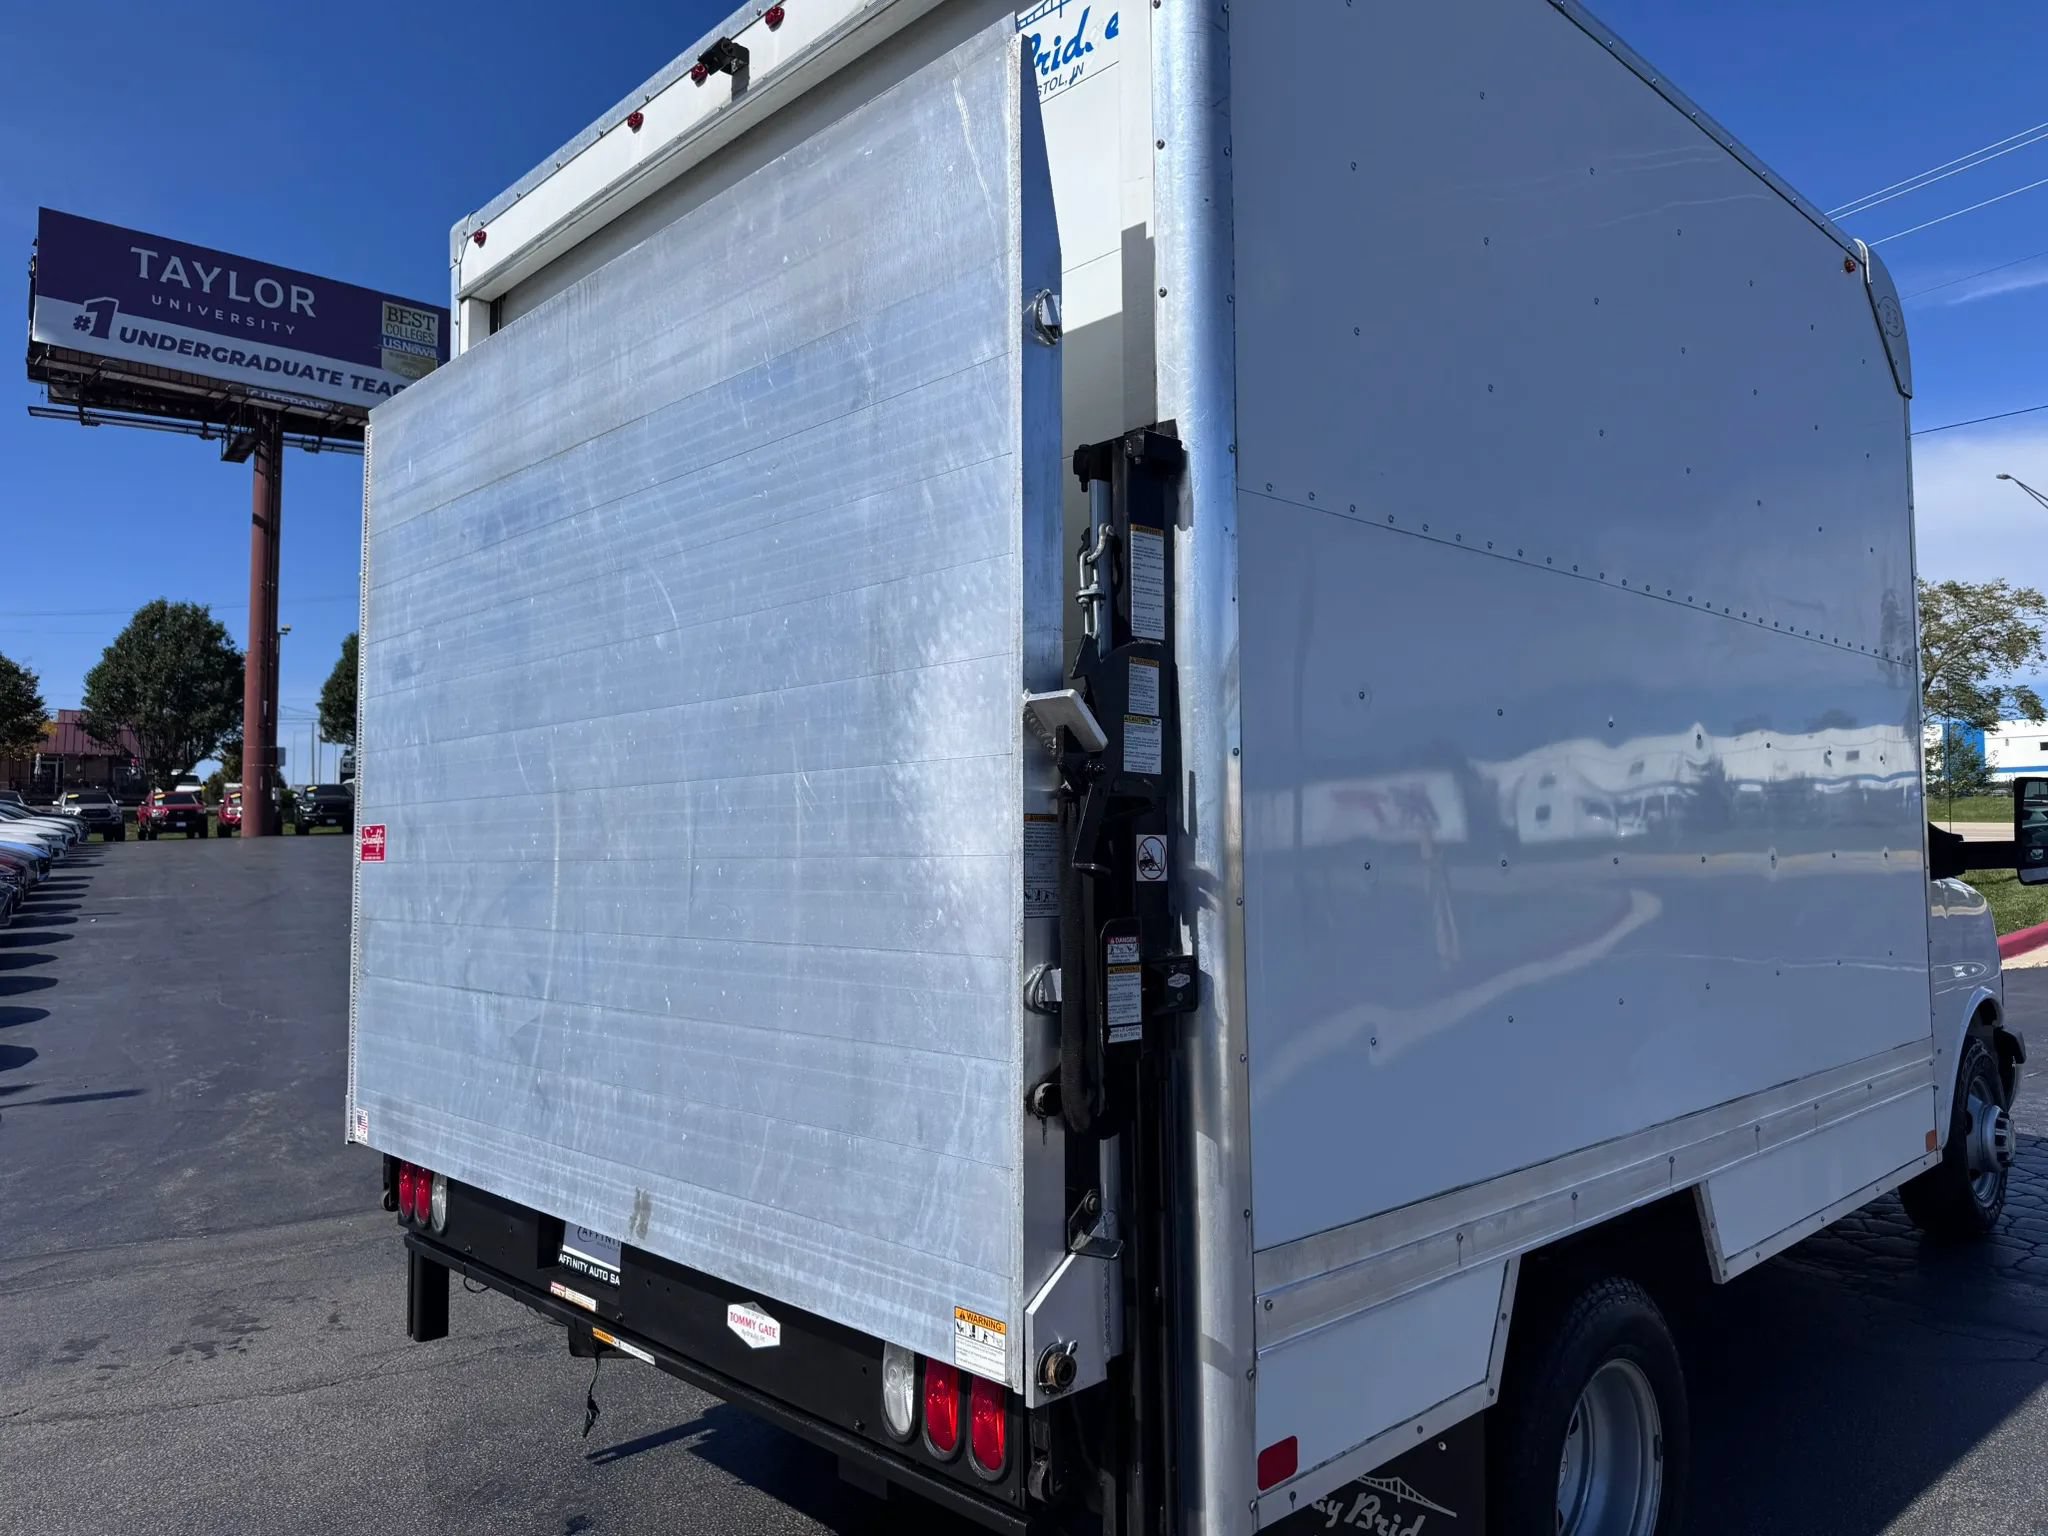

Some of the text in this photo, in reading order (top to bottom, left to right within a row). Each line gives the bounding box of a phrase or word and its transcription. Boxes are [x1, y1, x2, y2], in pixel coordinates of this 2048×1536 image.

[130, 246, 317, 318] TAYLOR
[151, 295, 296, 335] UNIVERSITY
[387, 305, 436, 331] BEST
[73, 297, 119, 340] #1
[119, 325, 345, 389] UNDERGRADUATE
[385, 322, 435, 345] COLLEGES
[558, 1253, 621, 1286] AFFINITY AUTO SA
[729, 1311, 757, 1330] TOMMY
[758, 1322, 777, 1339] GATE
[966, 1312, 1002, 1331] WARNING
